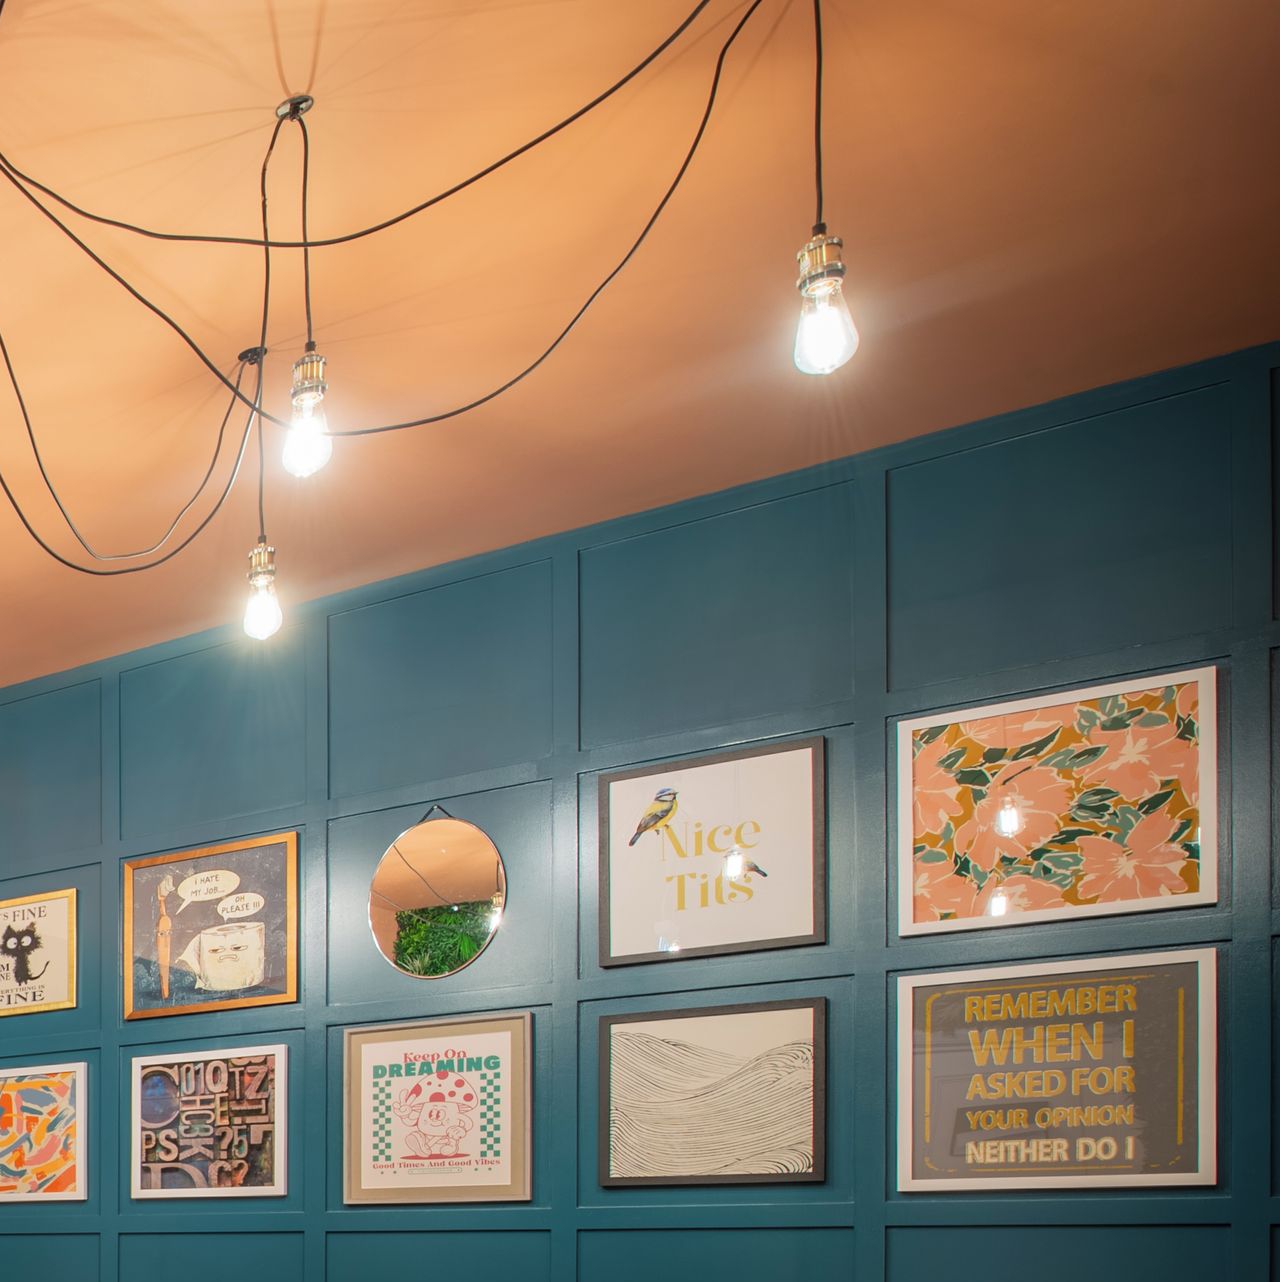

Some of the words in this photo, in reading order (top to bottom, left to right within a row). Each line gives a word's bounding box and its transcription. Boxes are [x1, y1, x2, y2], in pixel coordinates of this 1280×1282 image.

[660, 819, 761, 861] Nice
[199, 874, 220, 884] HATE
[665, 868, 754, 912] Tits
[191, 889, 201, 897] MY
[235, 895, 245, 903] OH
[12, 905, 47, 922] FINE
[221, 902, 250, 914] PLEASE
[964, 984, 1137, 1023] REMEMBER
[967, 1020, 1104, 1067] WHEN
[1122, 1019, 1135, 1059] I
[372, 1055, 501, 1079] DREAMING
[403, 1051, 441, 1064] Keep
[444, 1048, 467, 1059] On
[965, 1069, 1067, 1101] ASKED
[1071, 1065, 1137, 1096] FOR
[966, 1108, 1030, 1130] YOUR
[1035, 1104, 1135, 1128] OPINION
[965, 1138, 1069, 1164] NEITHER
[1076, 1136, 1118, 1162] DO
[1125, 1135, 1135, 1161] I
[372, 1162, 395, 1170] Good
[398, 1161, 425, 1169] Times
[427, 1160, 446, 1168] And
[448, 1159, 472, 1167] Good
[474, 1158, 501, 1166] Vibes
